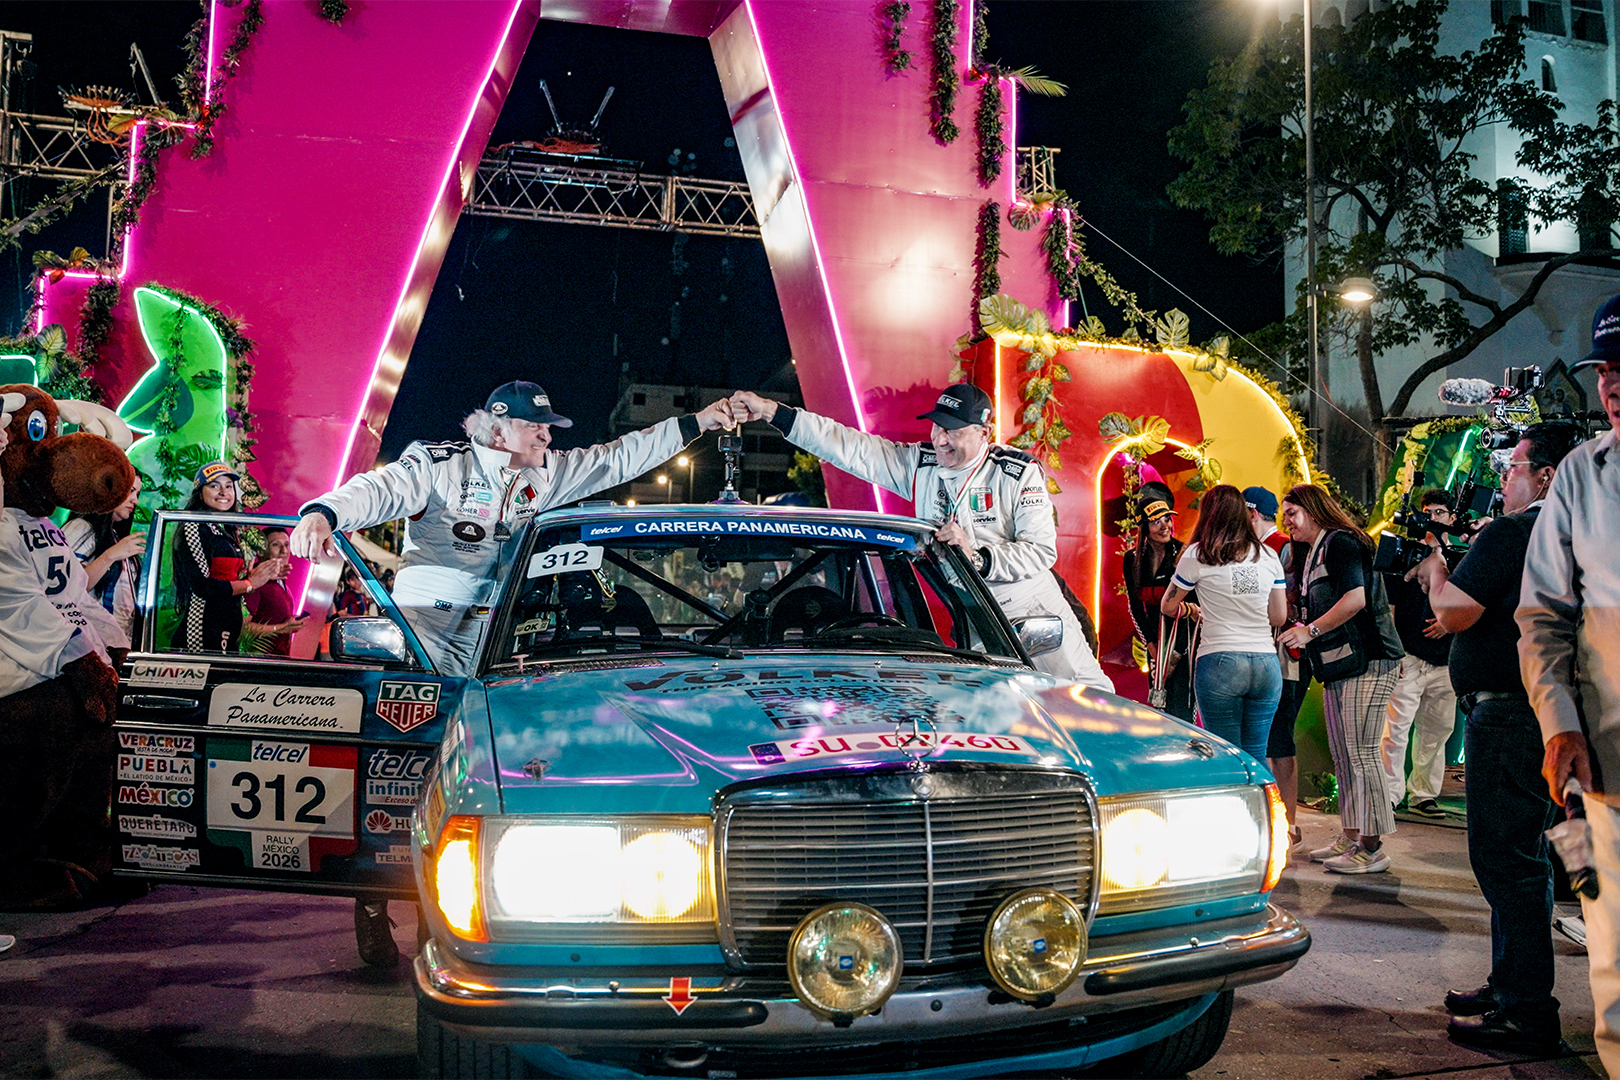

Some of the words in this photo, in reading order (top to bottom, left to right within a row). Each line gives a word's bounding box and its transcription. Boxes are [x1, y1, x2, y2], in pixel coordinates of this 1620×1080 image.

[590, 525, 623, 535] telcel
[634, 521, 724, 533] CARRERA
[727, 521, 867, 540] PANAMERICANA
[876, 533, 905, 544] telcel
[541, 550, 589, 569] 312
[524, 623, 538, 632] OK
[133, 663, 206, 679] CHIAPAS
[240, 686, 266, 703] La
[272, 687, 336, 707] Carrera
[385, 684, 435, 700] TAG
[378, 701, 434, 729] HEUER
[120, 733, 193, 750] VERACRUZ
[790, 738, 852, 757] SU
[252, 743, 309, 763] telcel
[120, 757, 192, 775] PUEBLA
[230, 771, 327, 825] 312
[266, 835, 295, 845] RALLY
[262, 844, 300, 854] MÉXICO
[261, 853, 301, 869] 2026
[378, 854, 413, 863] TELM
